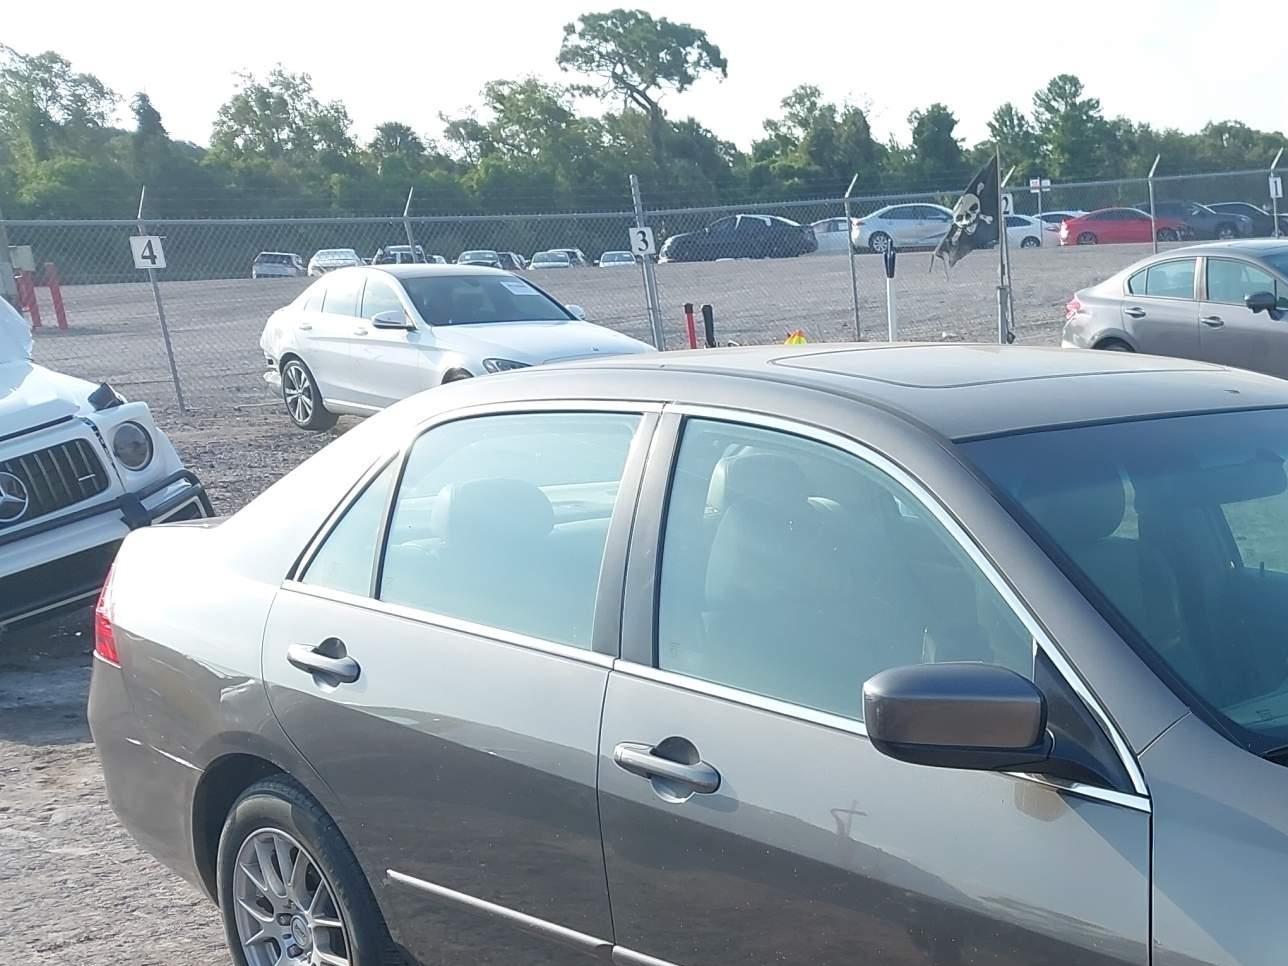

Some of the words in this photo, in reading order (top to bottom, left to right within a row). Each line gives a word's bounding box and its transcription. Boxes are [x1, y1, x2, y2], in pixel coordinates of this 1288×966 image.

[1001, 196, 1009, 214] 2
[636, 230, 649, 251] 3
[141, 239, 158, 265] 4
